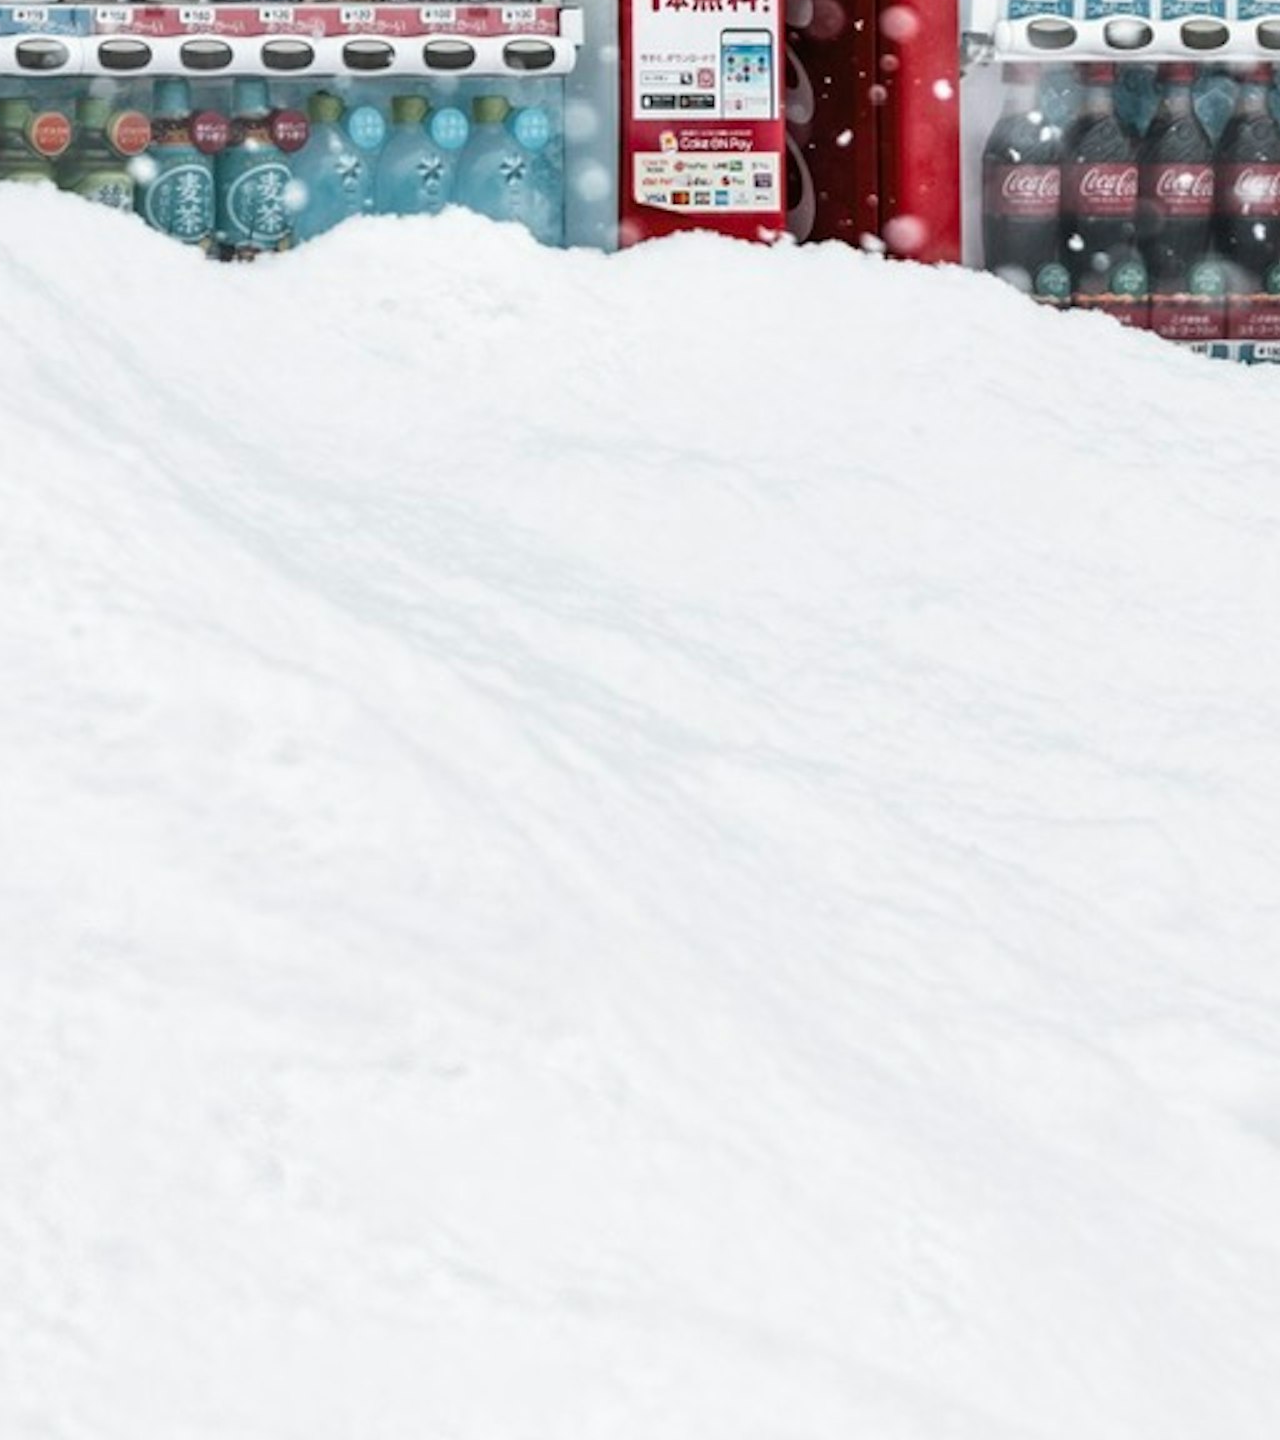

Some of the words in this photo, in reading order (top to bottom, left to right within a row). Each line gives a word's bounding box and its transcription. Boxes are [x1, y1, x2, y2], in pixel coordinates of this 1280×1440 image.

[680, 137, 705, 151] Coke
[710, 137, 728, 151] ON
[730, 137, 753, 152] Pay
[175, 171, 202, 234] 麦茶
[257, 171, 285, 234] 麦茶
[645, 193, 668, 203] VISA
